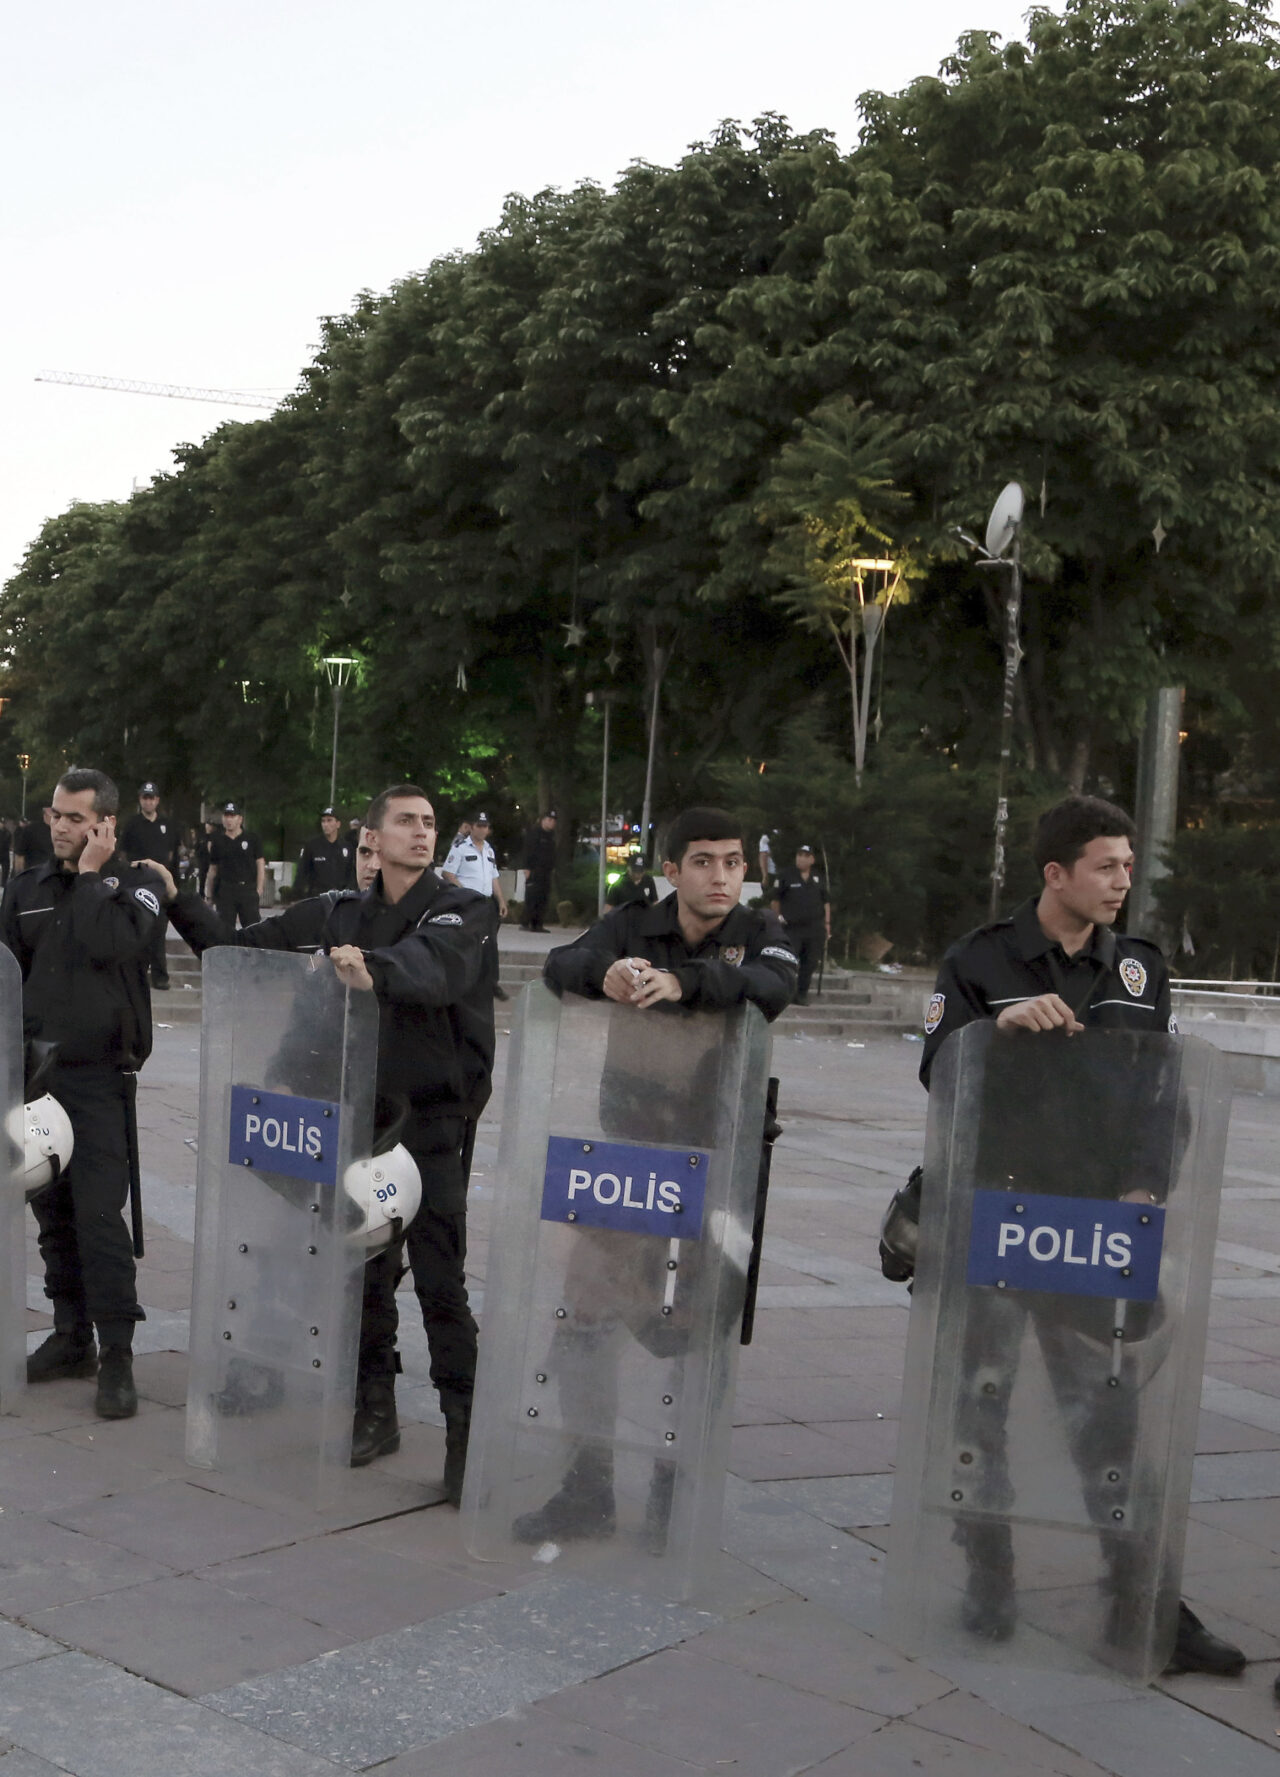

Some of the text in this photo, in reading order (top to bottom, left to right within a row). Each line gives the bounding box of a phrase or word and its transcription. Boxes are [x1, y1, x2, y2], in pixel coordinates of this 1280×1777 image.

[245, 1114, 322, 1156] POLİS
[376, 1183, 397, 1203] 90
[568, 1169, 681, 1213] POLİS
[997, 1222, 1132, 1268] POLİS
